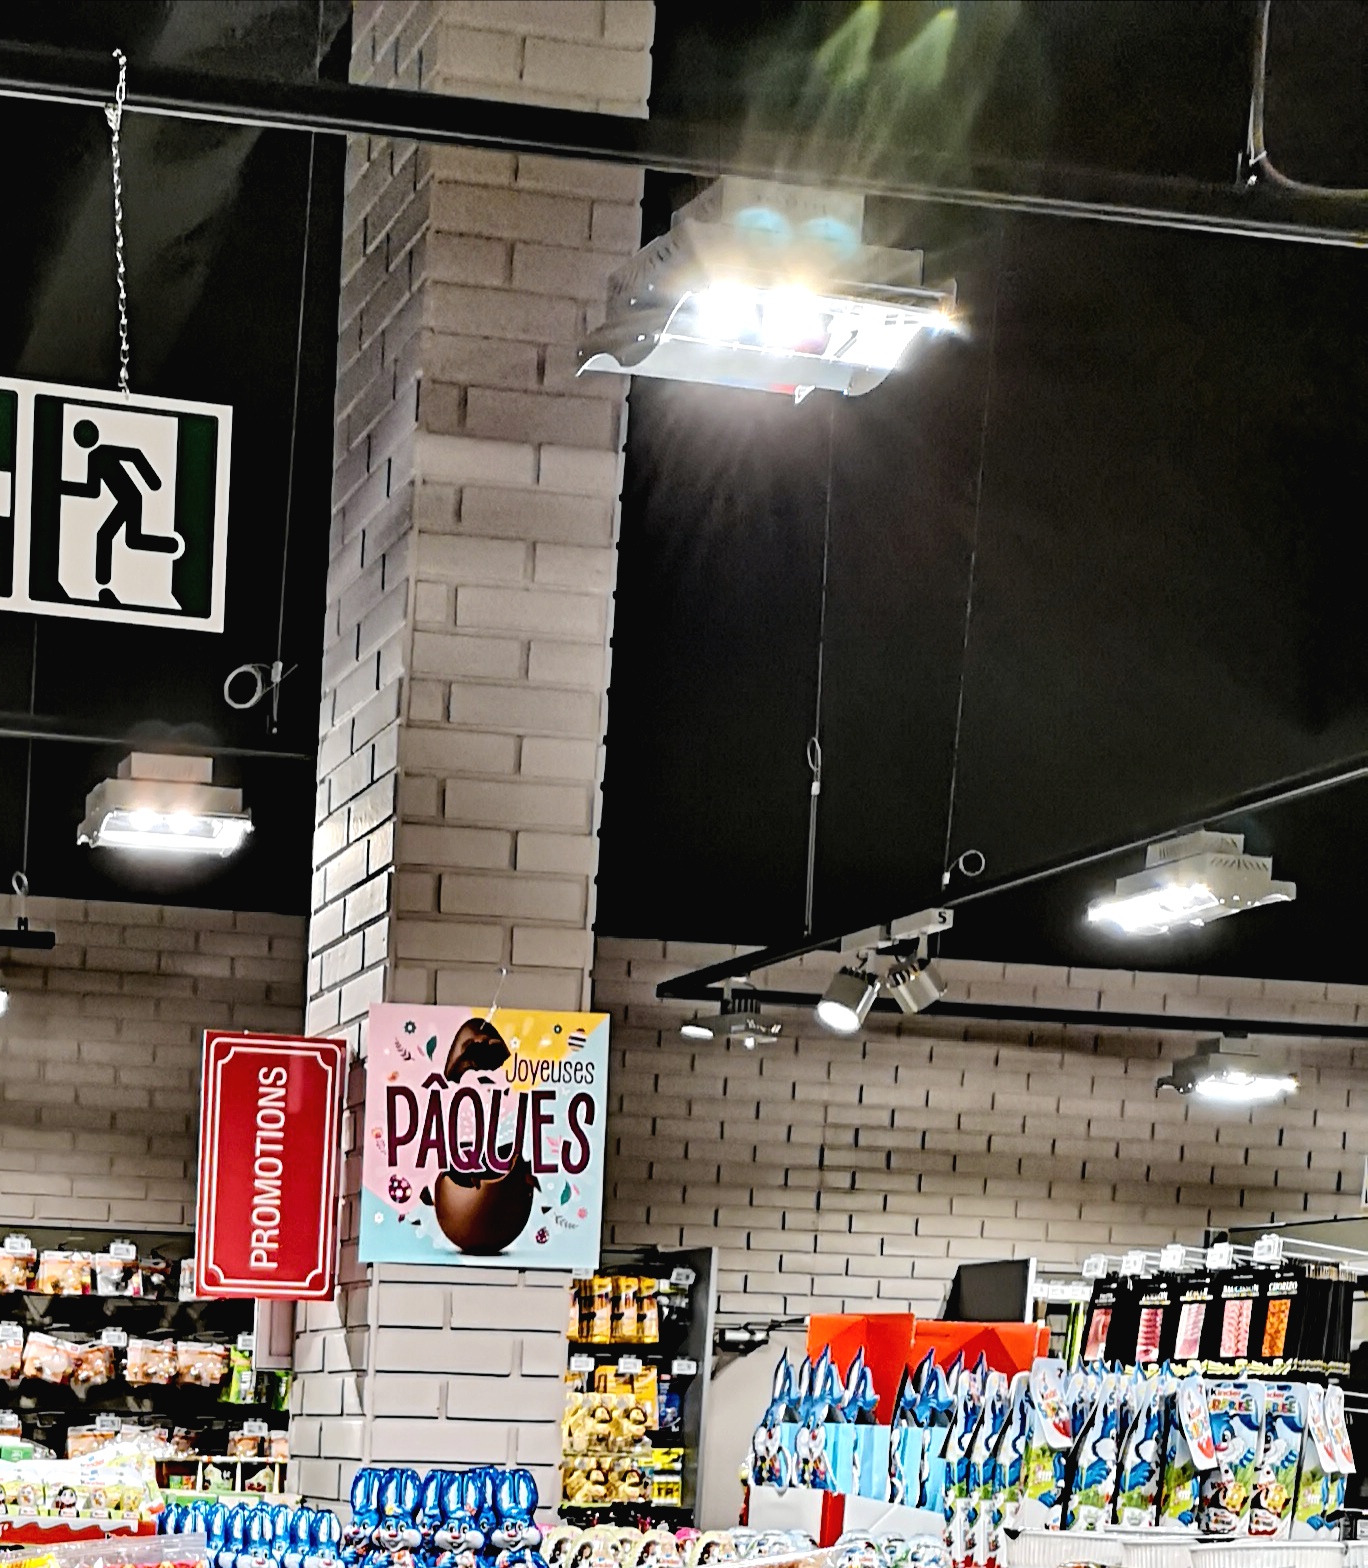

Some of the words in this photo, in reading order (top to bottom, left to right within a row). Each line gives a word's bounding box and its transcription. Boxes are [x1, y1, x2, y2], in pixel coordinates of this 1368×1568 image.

[505, 1051, 596, 1086] Joyeuses
[249, 1065, 288, 1271] PROMOTIONS
[385, 1073, 596, 1176] PÂQUES
